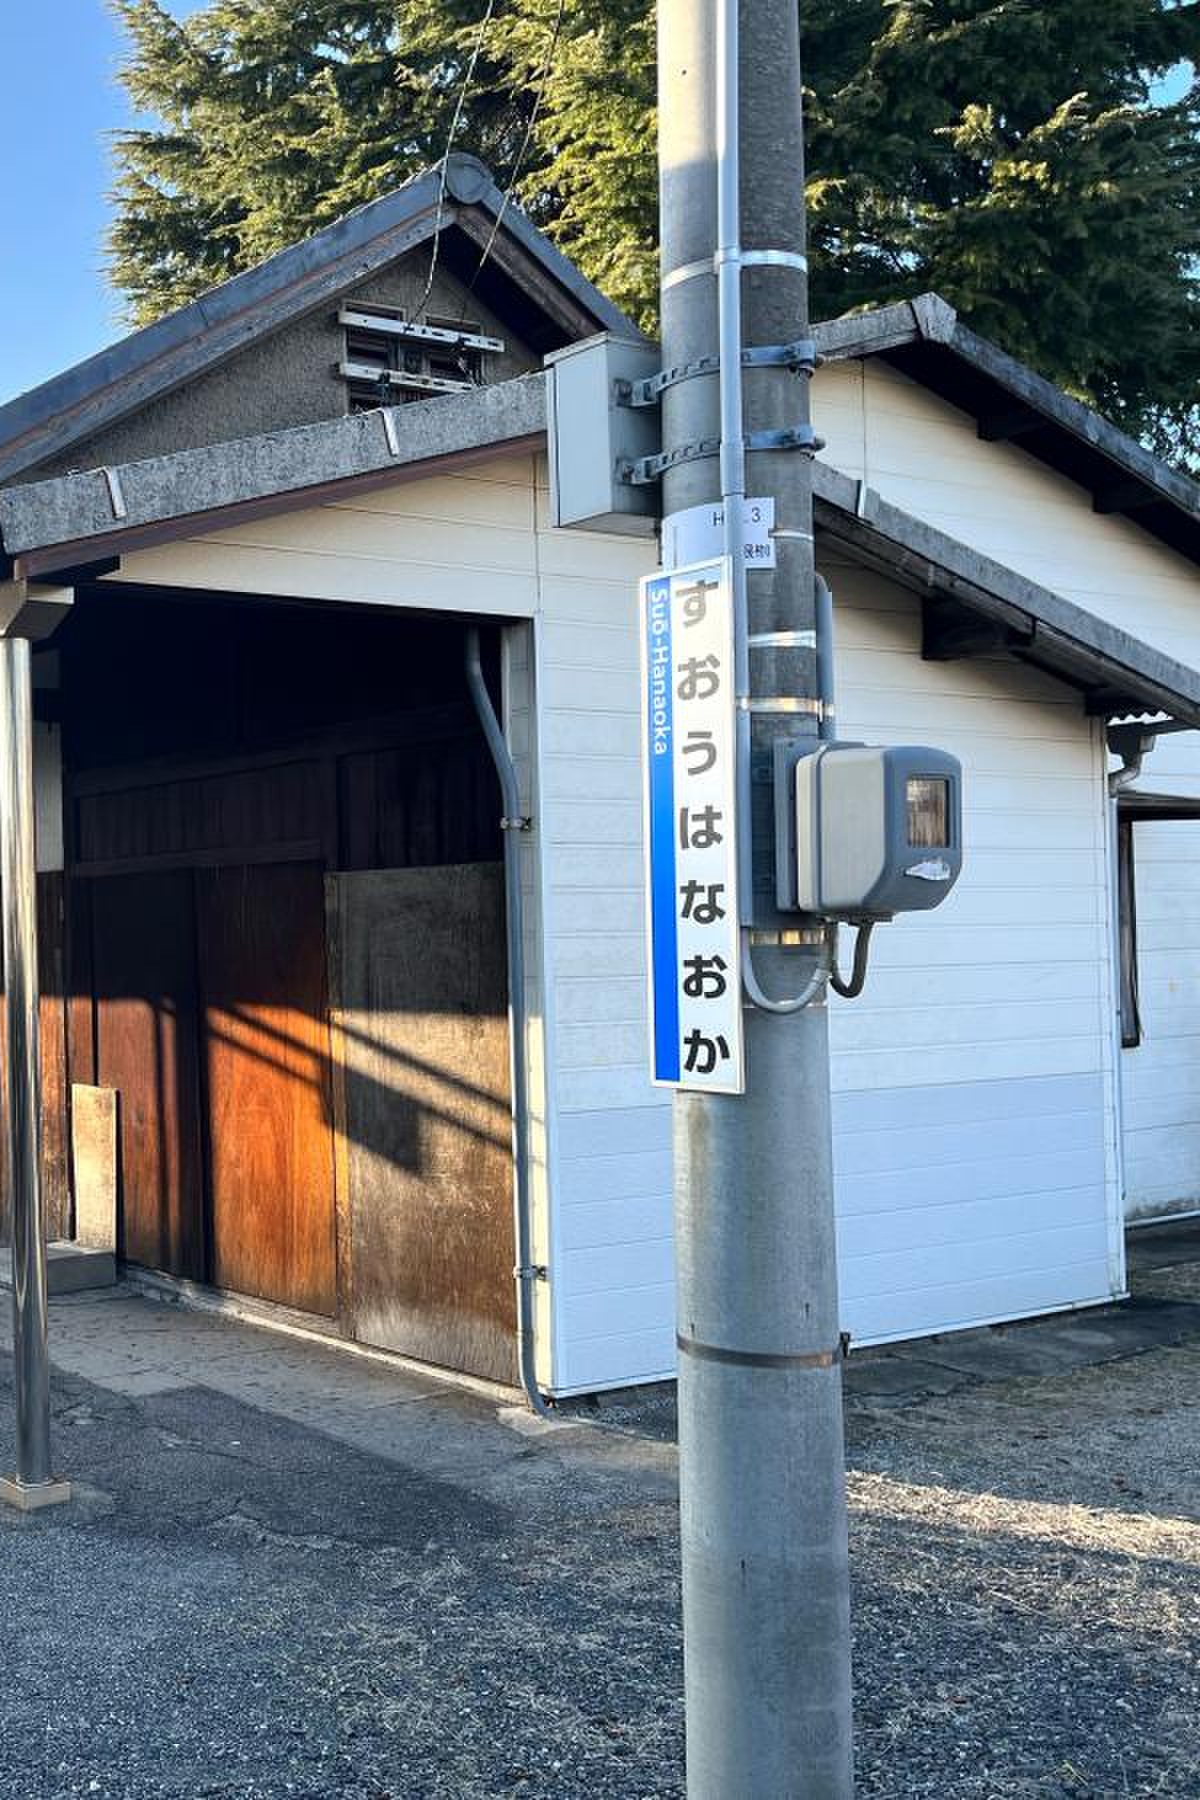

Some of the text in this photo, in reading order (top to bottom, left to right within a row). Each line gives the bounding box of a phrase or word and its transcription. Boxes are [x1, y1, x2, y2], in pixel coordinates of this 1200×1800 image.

[651, 588, 671, 755] Suo-Hanaoka
[675, 579, 730, 1074] すおうはなおか
